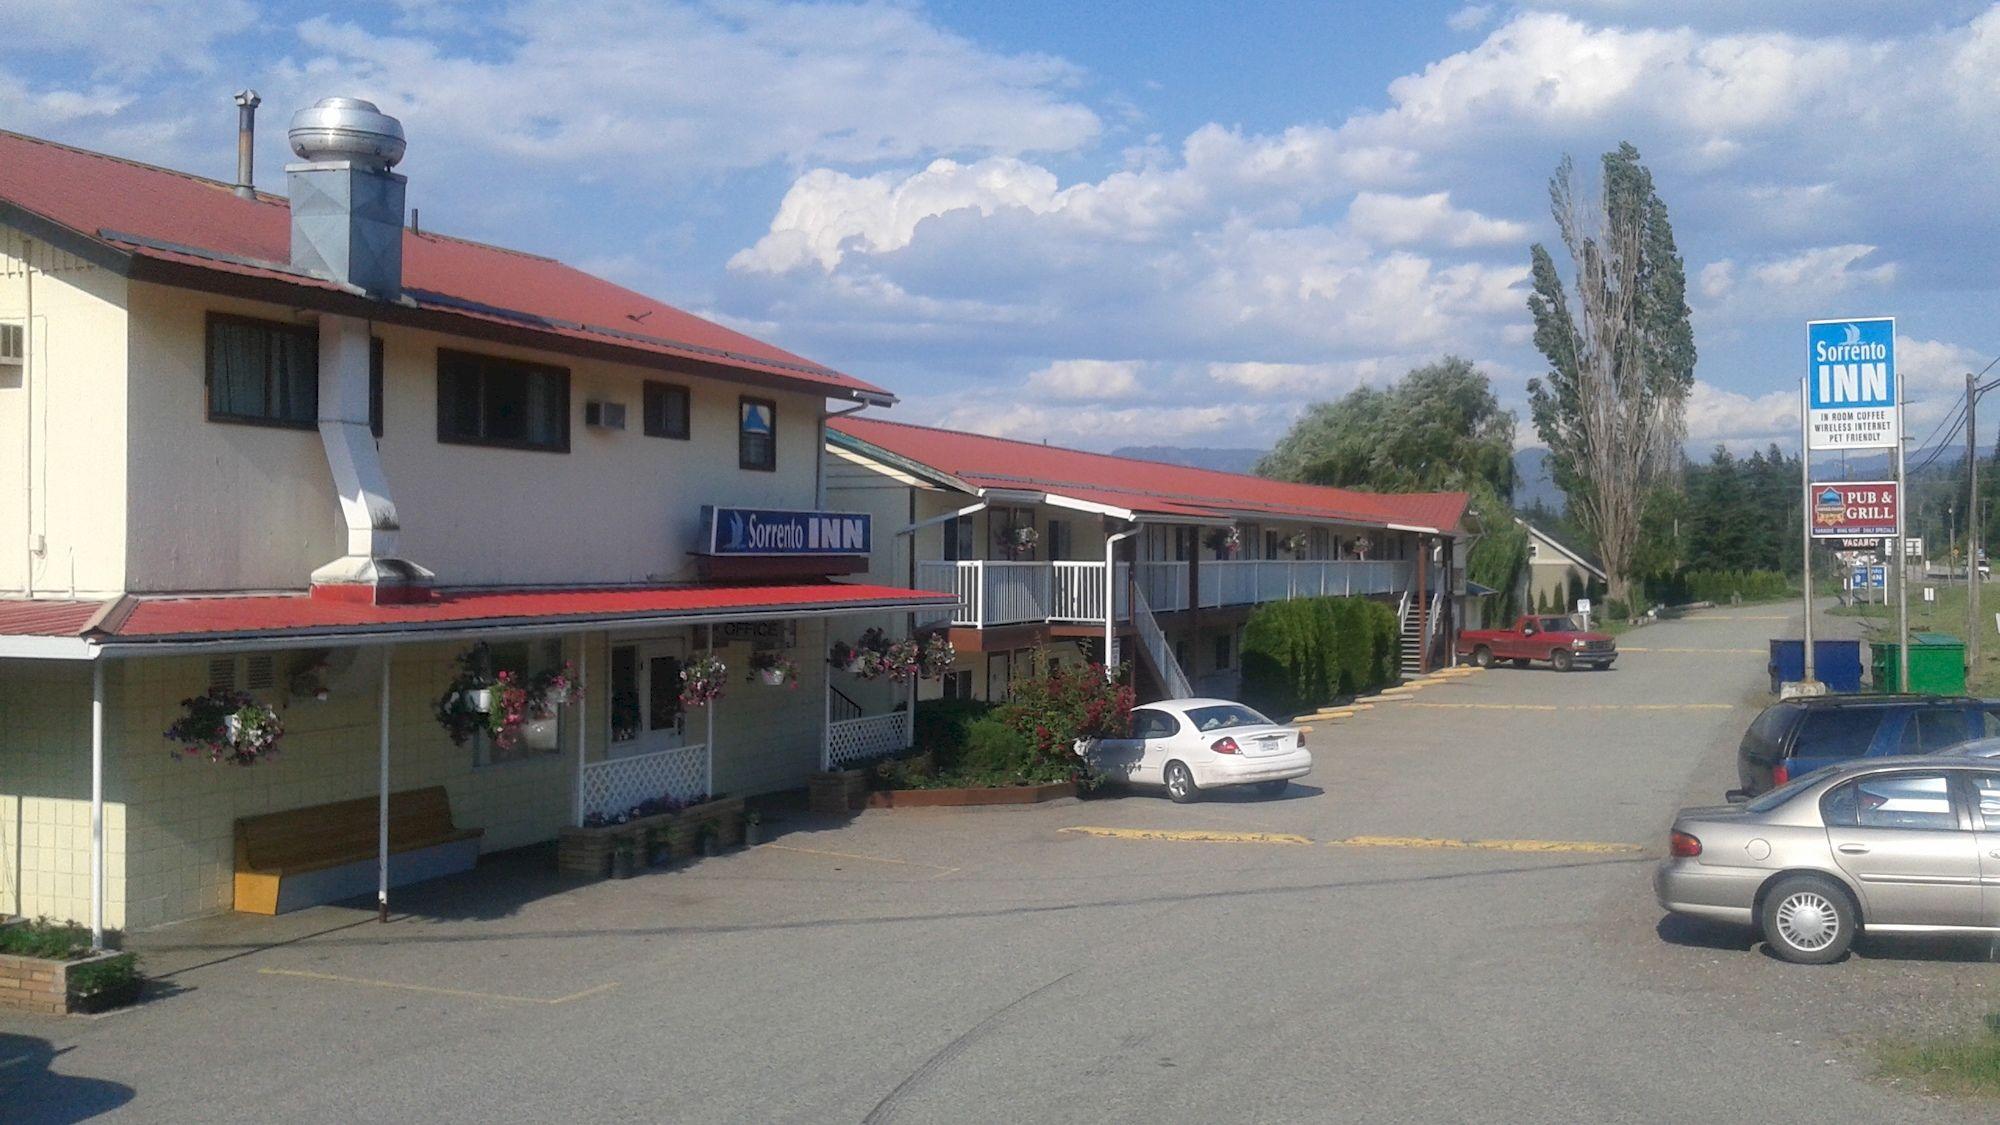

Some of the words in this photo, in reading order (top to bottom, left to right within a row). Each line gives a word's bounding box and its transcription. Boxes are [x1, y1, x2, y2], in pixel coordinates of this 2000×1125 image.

[1816, 340, 1886, 362] Sorrento
[1818, 362, 1887, 403] INN
[1821, 413, 1829, 421] IN
[1832, 412, 1853, 420] ROOM
[1857, 411, 1885, 420] COFFEE
[1814, 422, 1852, 432] WIRELESS
[1855, 421, 1891, 431] INTERNET
[1829, 433, 1842, 442] PET
[1846, 432, 1881, 441] FRIENDLY
[1847, 491, 1877, 504] PUB
[1881, 491, 1892, 504] &
[1846, 506, 1894, 519] GRILL
[748, 513, 804, 549] Sorrento
[808, 517, 863, 549] INN
[1842, 538, 1881, 547] VACANCY
[724, 620, 779, 637] OFFICE
